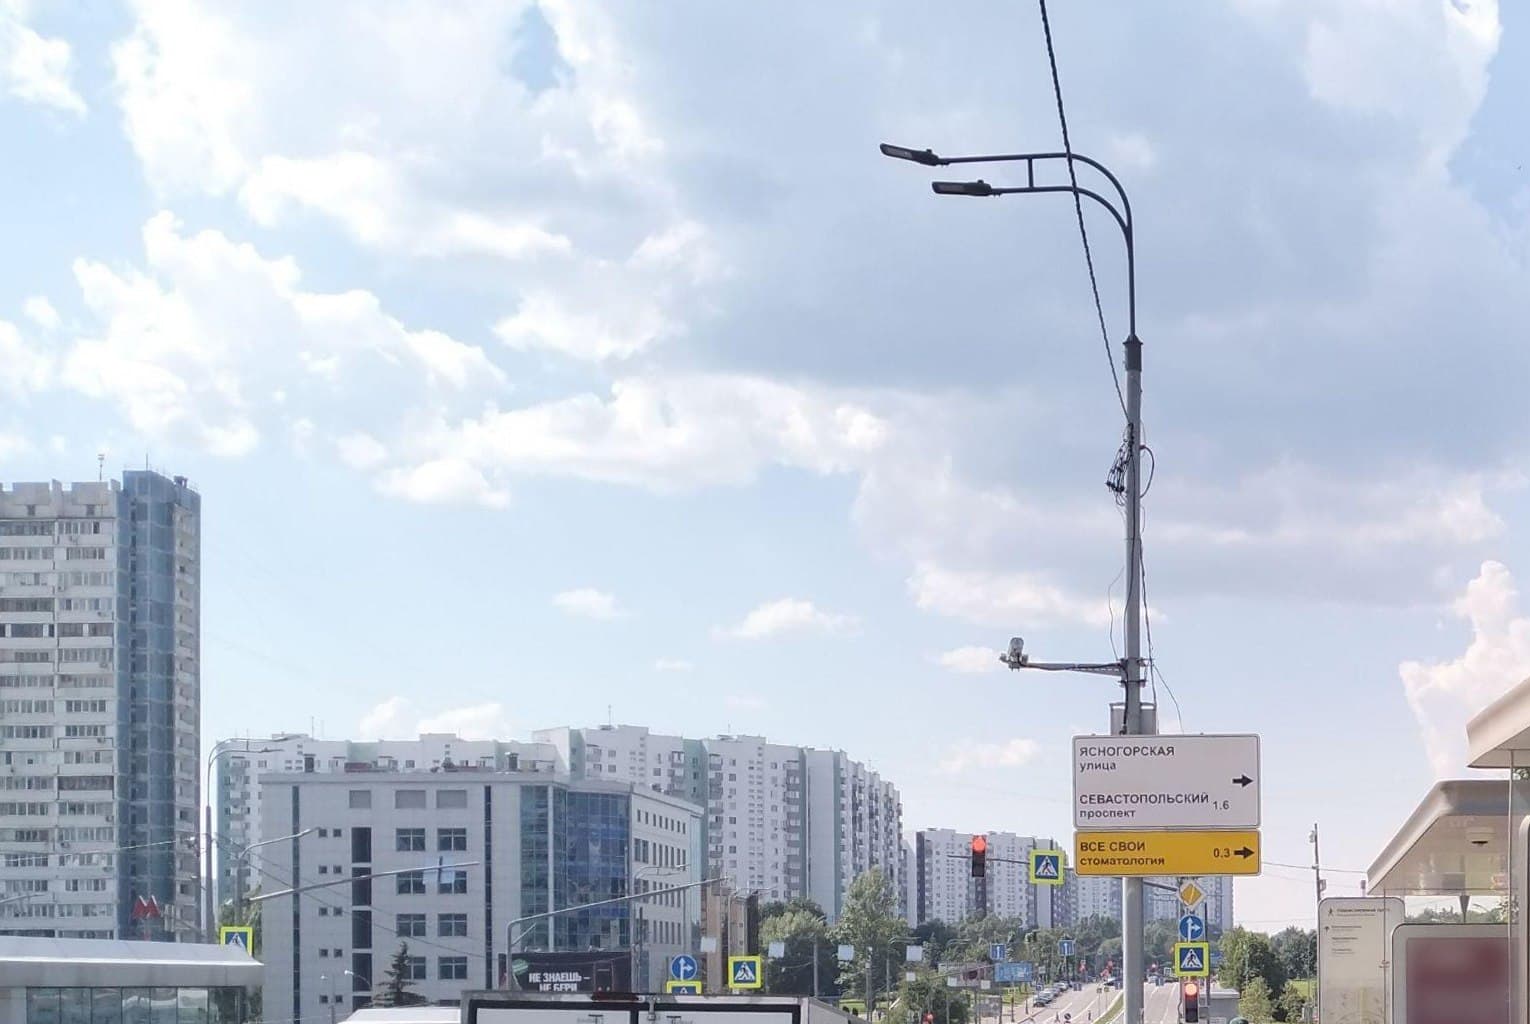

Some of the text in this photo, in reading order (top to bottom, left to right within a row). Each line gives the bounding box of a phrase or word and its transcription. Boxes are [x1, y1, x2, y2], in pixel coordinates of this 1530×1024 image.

[1079, 746, 1175, 757] ЯСНОГОРСКАЯ
[1079, 761, 1117, 772] улица
[1079, 792, 1230, 810] СЕВАСТОПОЛЬСКИЙ 1.6
[1079, 808, 1136, 819] проспект
[1080, 842, 1231, 858] ВСЕ СВОИ 0.3
[1080, 857, 1165, 866] стоматология
[529, 973, 541, 983] НЕ
[543, 972, 582, 983] ЗНАЕШЬ
